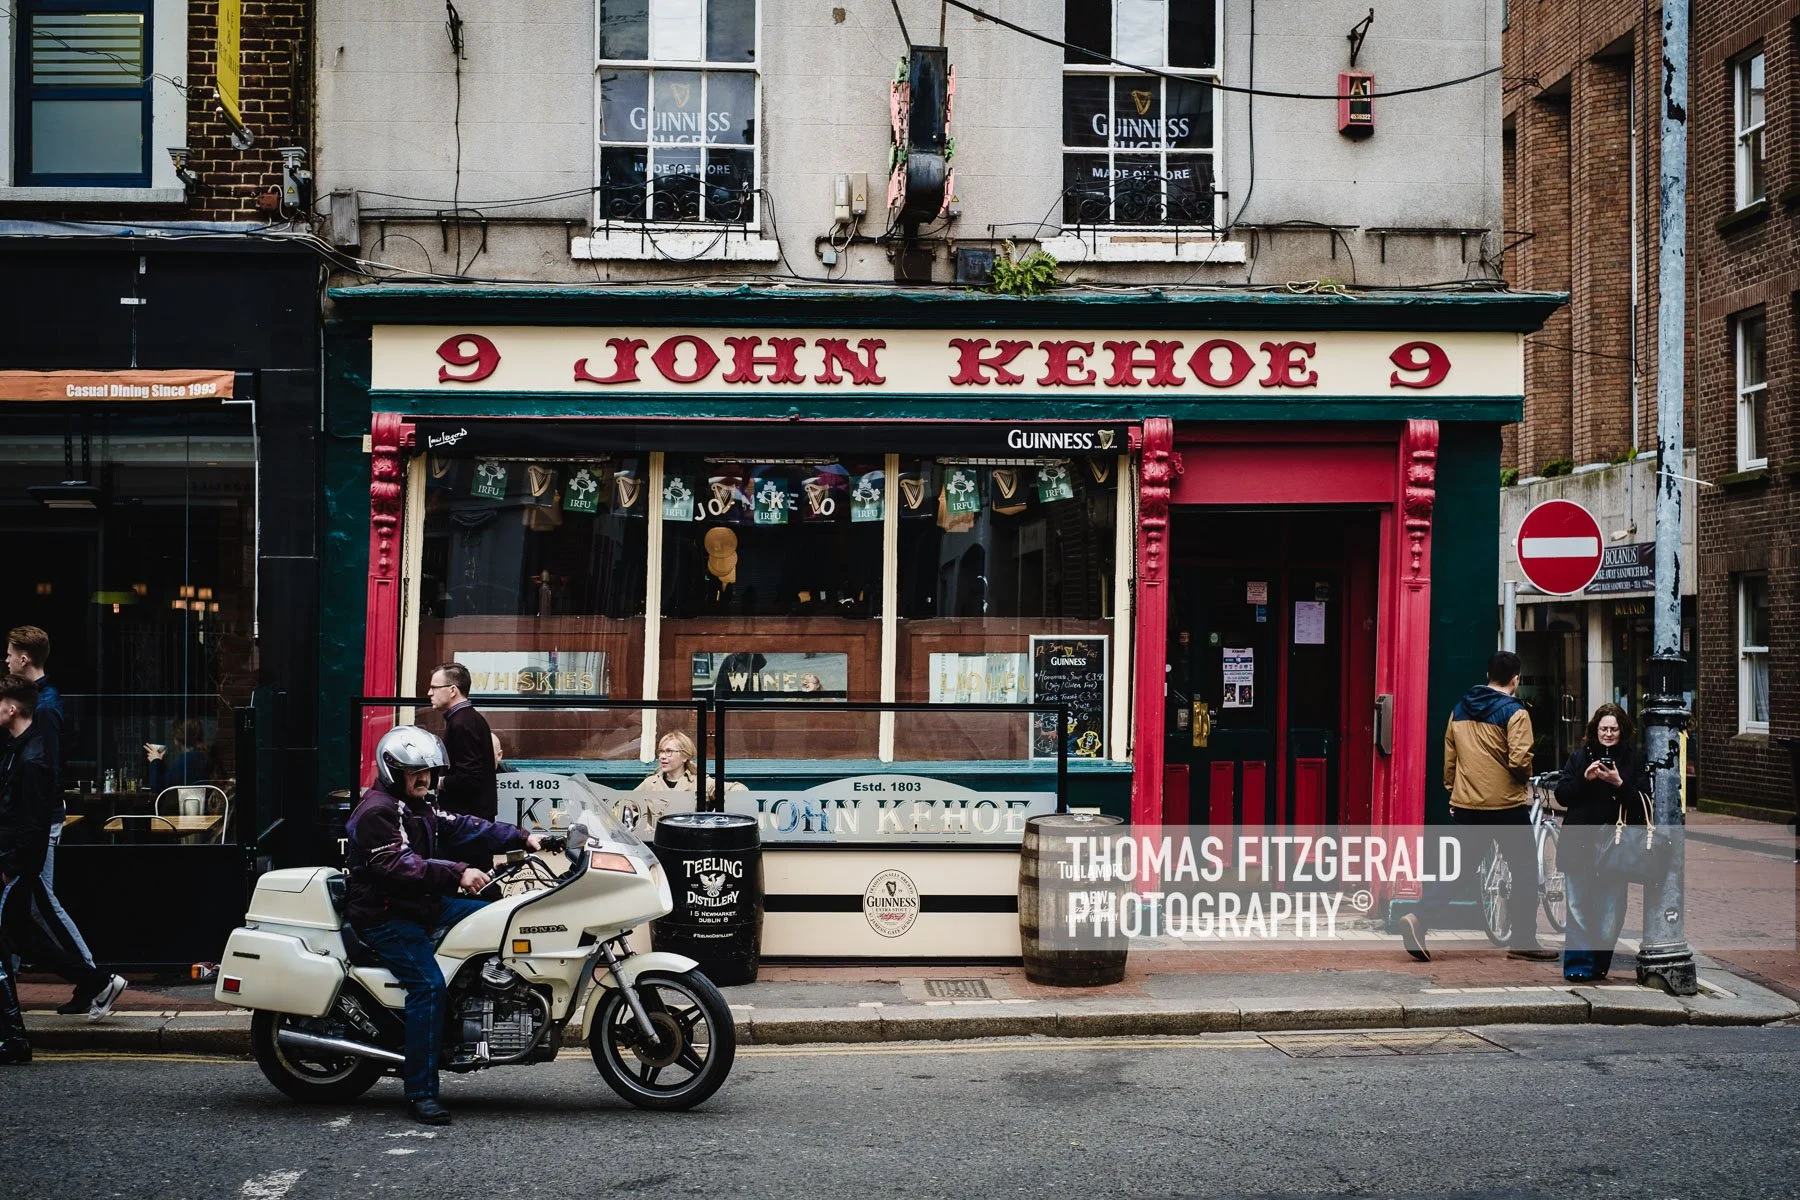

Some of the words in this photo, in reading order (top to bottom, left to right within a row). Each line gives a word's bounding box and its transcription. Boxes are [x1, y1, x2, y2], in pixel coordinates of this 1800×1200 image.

[629, 107, 731, 132] GUINNESS
[1092, 113, 1189, 138] GUINNESS
[436, 333, 501, 384] 9
[574, 335, 888, 386] JOHN
[947, 337, 1318, 388] KEHOE
[1388, 341, 1452, 388] 9
[66, 384, 108, 398] Casual
[111, 384, 149, 399] Dining
[152, 384, 186, 398] Since
[189, 382, 217, 396] 1993
[1007, 429, 1093, 449] GUINNESS
[478, 484, 500, 495] IRFU
[1045, 488, 1066, 498] IRFU
[570, 499, 591, 509] IRFU
[952, 501, 974, 511] IRFU
[665, 508, 688, 518] IRFU
[760, 512, 781, 520] IRFU
[857, 509, 878, 518] IRFU
[1051, 656, 1087, 666] GUINNESS
[471, 672, 594, 691] WHISKIES
[727, 672, 815, 692] WINES
[528, 780, 560, 790] 1803
[853, 782, 886, 792] Estd.
[890, 782, 922, 792] 1803
[755, 799, 862, 835] JOHN
[876, 799, 1033, 835] KEHOE
[683, 857, 743, 878] TEELING
[687, 890, 740, 907] DISTILLERY
[866, 895, 917, 908] GUINNESS
[519, 924, 568, 935] HONDA
